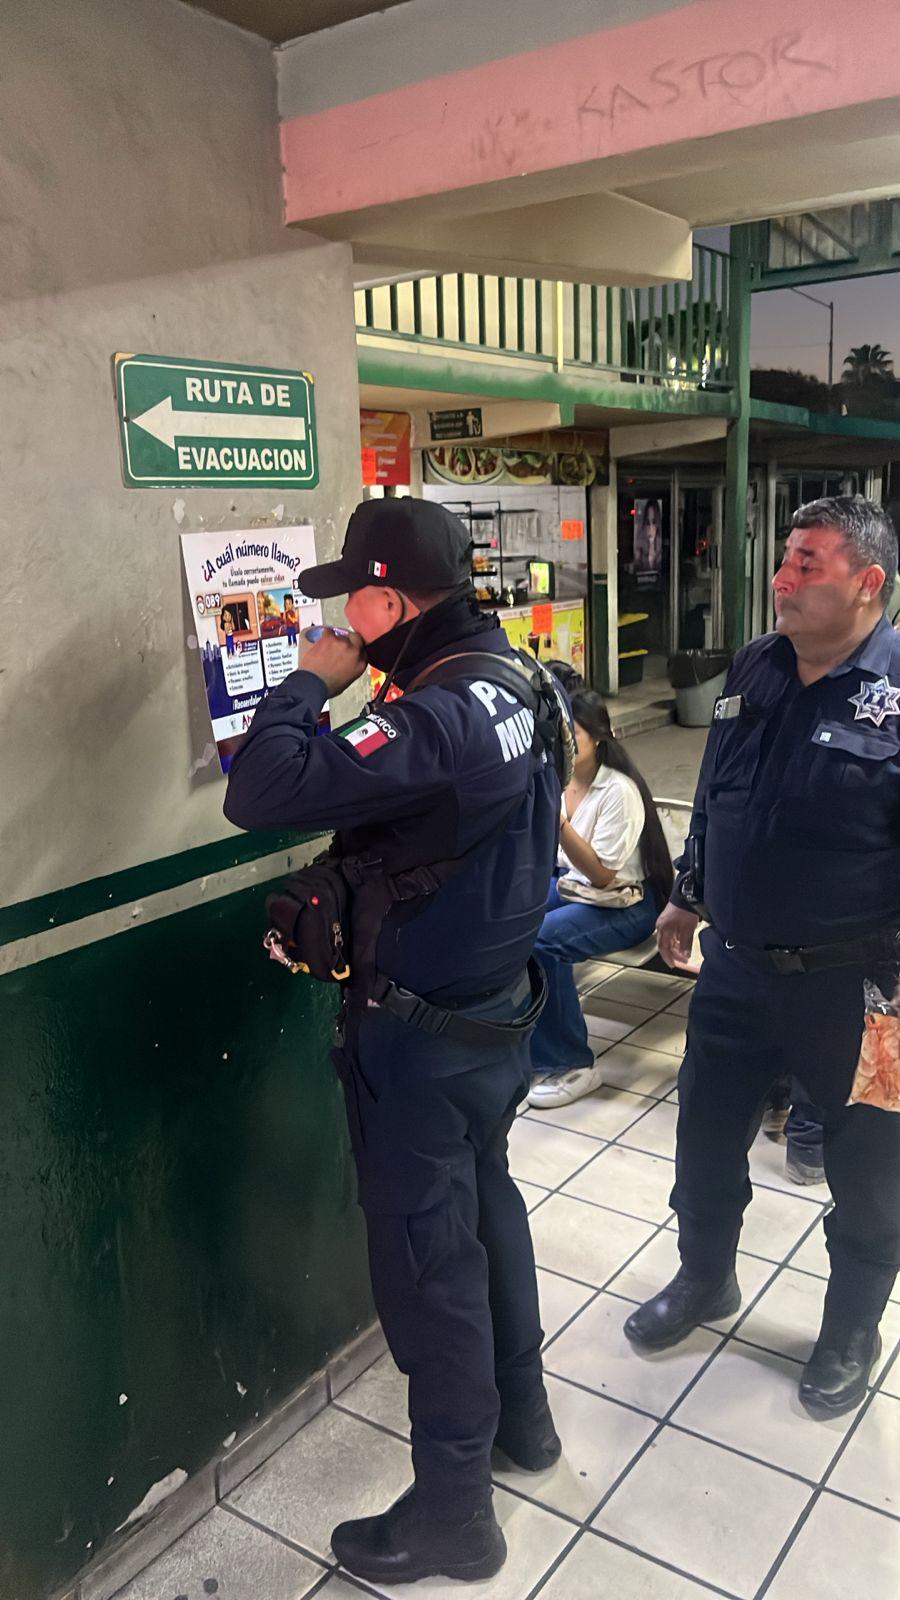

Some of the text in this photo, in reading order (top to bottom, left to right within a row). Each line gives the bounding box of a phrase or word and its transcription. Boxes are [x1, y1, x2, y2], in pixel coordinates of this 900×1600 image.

[185, 376, 291, 408] RUTA DE
[177, 446, 307, 472] EVACUACION
[201, 540, 301, 582] ¿A cuál número llamo?
[204, 593, 221, 609] 089
[365, 713, 397, 739] MEXICO
